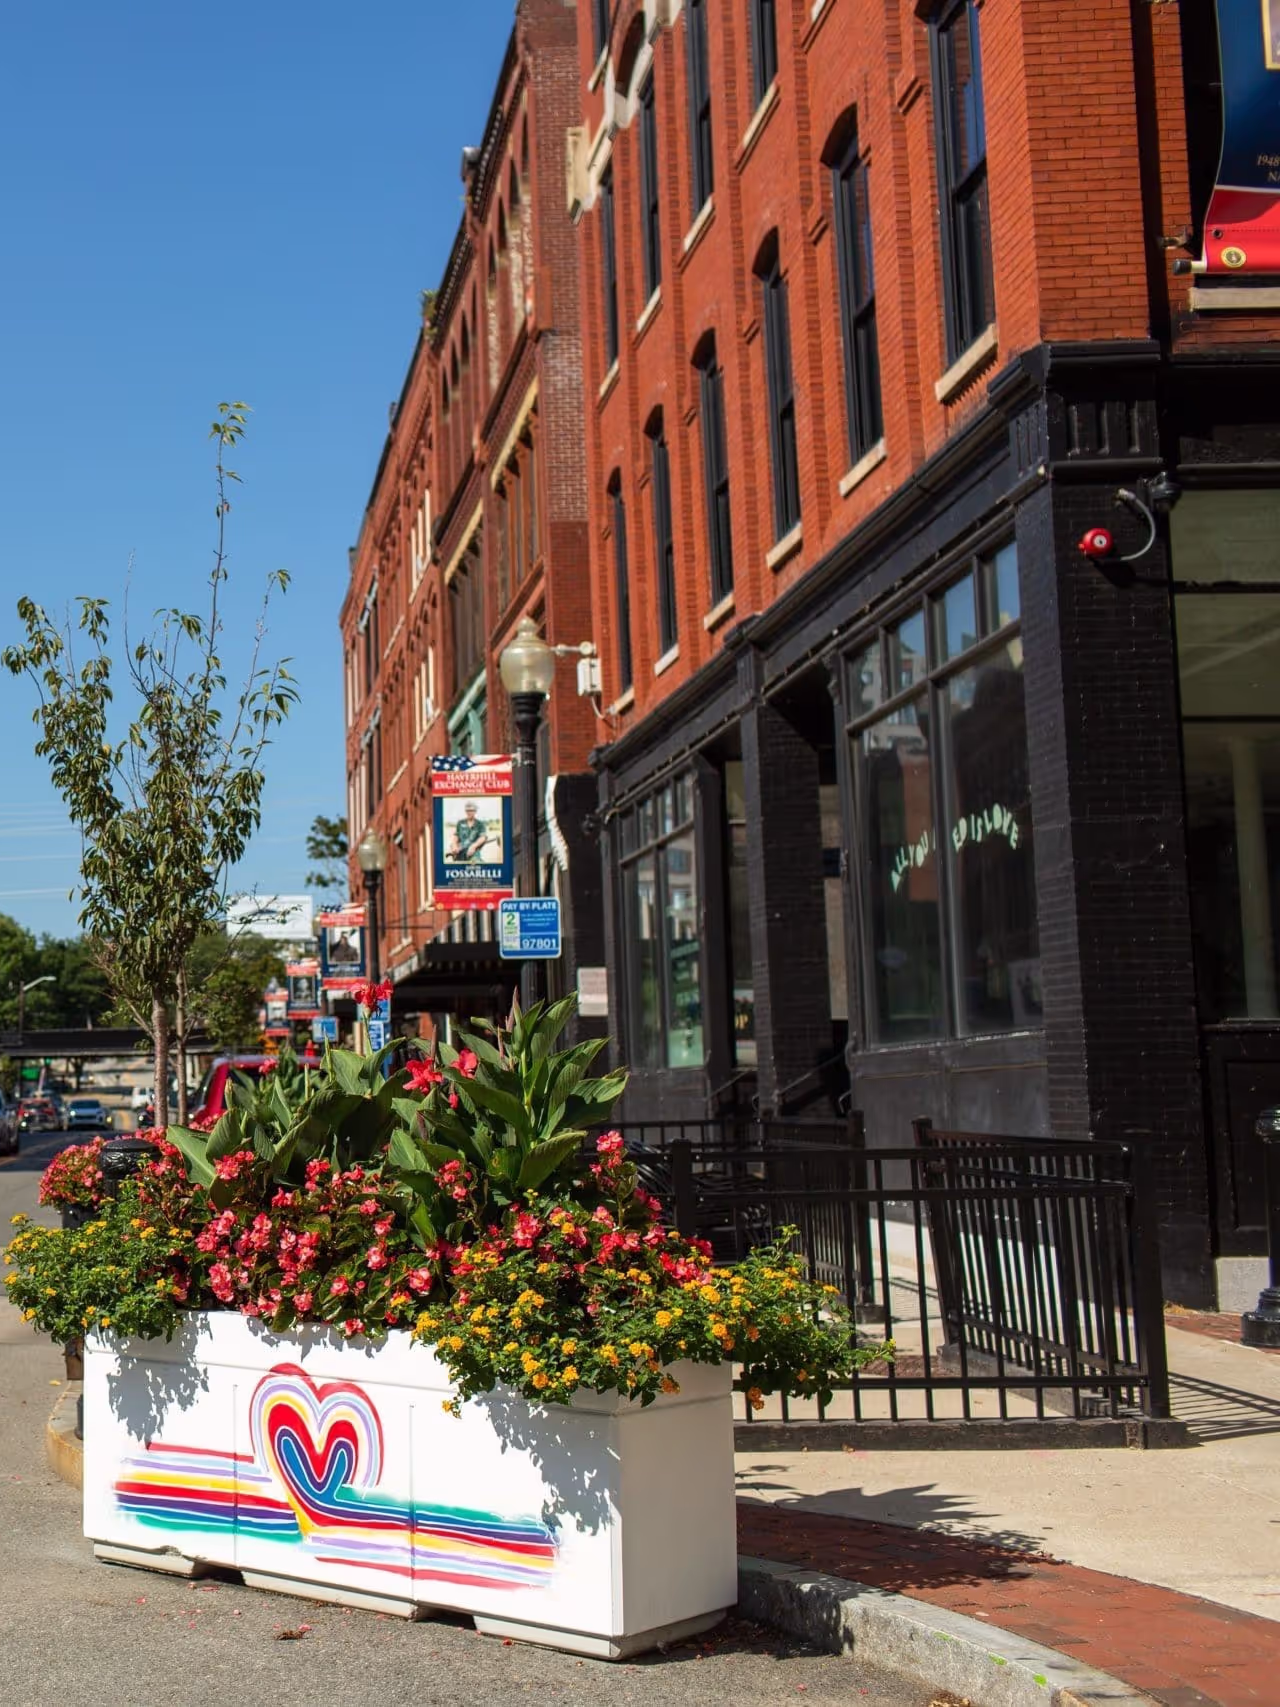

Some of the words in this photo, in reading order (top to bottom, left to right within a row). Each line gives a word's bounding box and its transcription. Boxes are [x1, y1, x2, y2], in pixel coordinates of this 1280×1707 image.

[447, 772, 496, 781] HAVERHILL
[434, 780, 483, 790] EXCHANGE
[485, 779, 510, 789] CLUB
[908, 829, 929, 868] YOU
[983, 802, 1019, 850] LOVE
[445, 869, 502, 879] FOSSARELLI
[503, 902, 518, 911] PAY
[519, 902, 531, 911] BY
[531, 901, 557, 911] PLATE
[506, 912, 516, 926] 2
